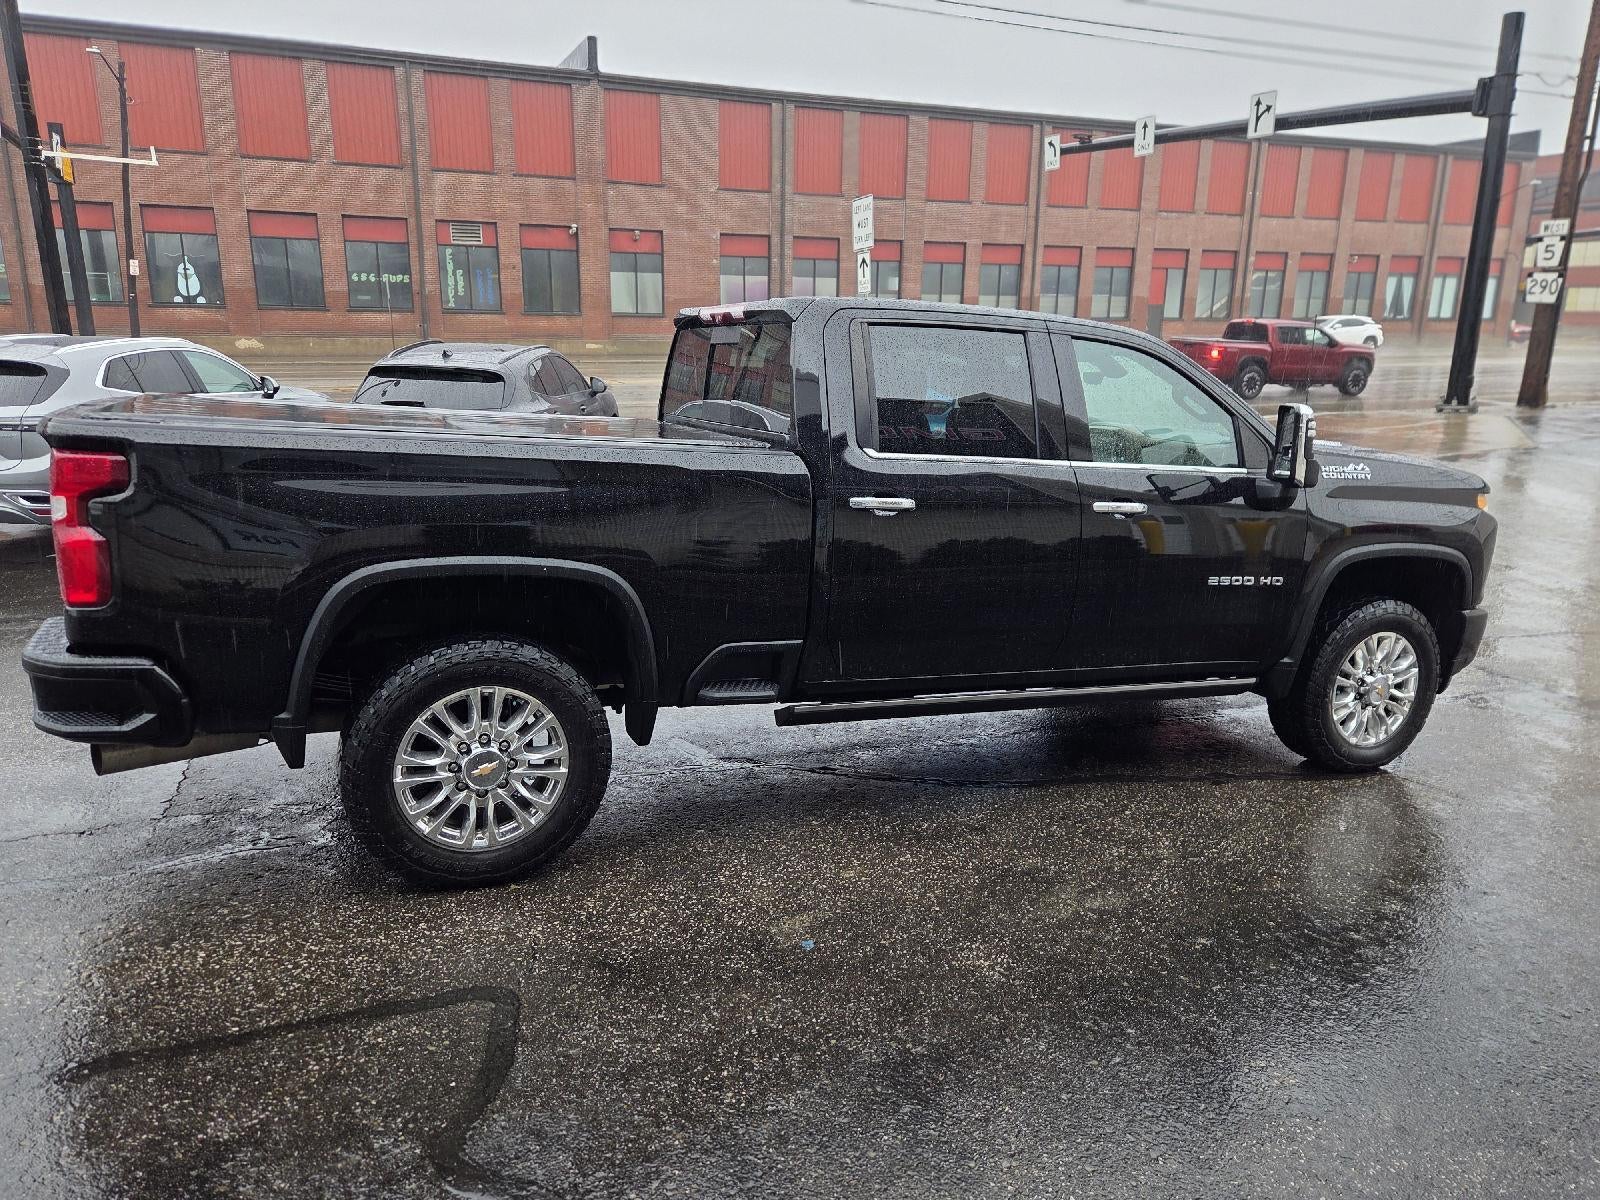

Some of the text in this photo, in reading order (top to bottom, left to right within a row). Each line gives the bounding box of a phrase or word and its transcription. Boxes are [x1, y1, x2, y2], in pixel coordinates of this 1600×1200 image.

[1137, 143, 1151, 152] ONLY
[1046, 159, 1058, 168] ONLY
[1543, 223, 1565, 233] WEST
[1543, 244, 1555, 261] 5
[1527, 278, 1559, 295] 290
[1321, 472, 1372, 480] COUNTRY
[1207, 576, 1284, 586] 2500 HD
